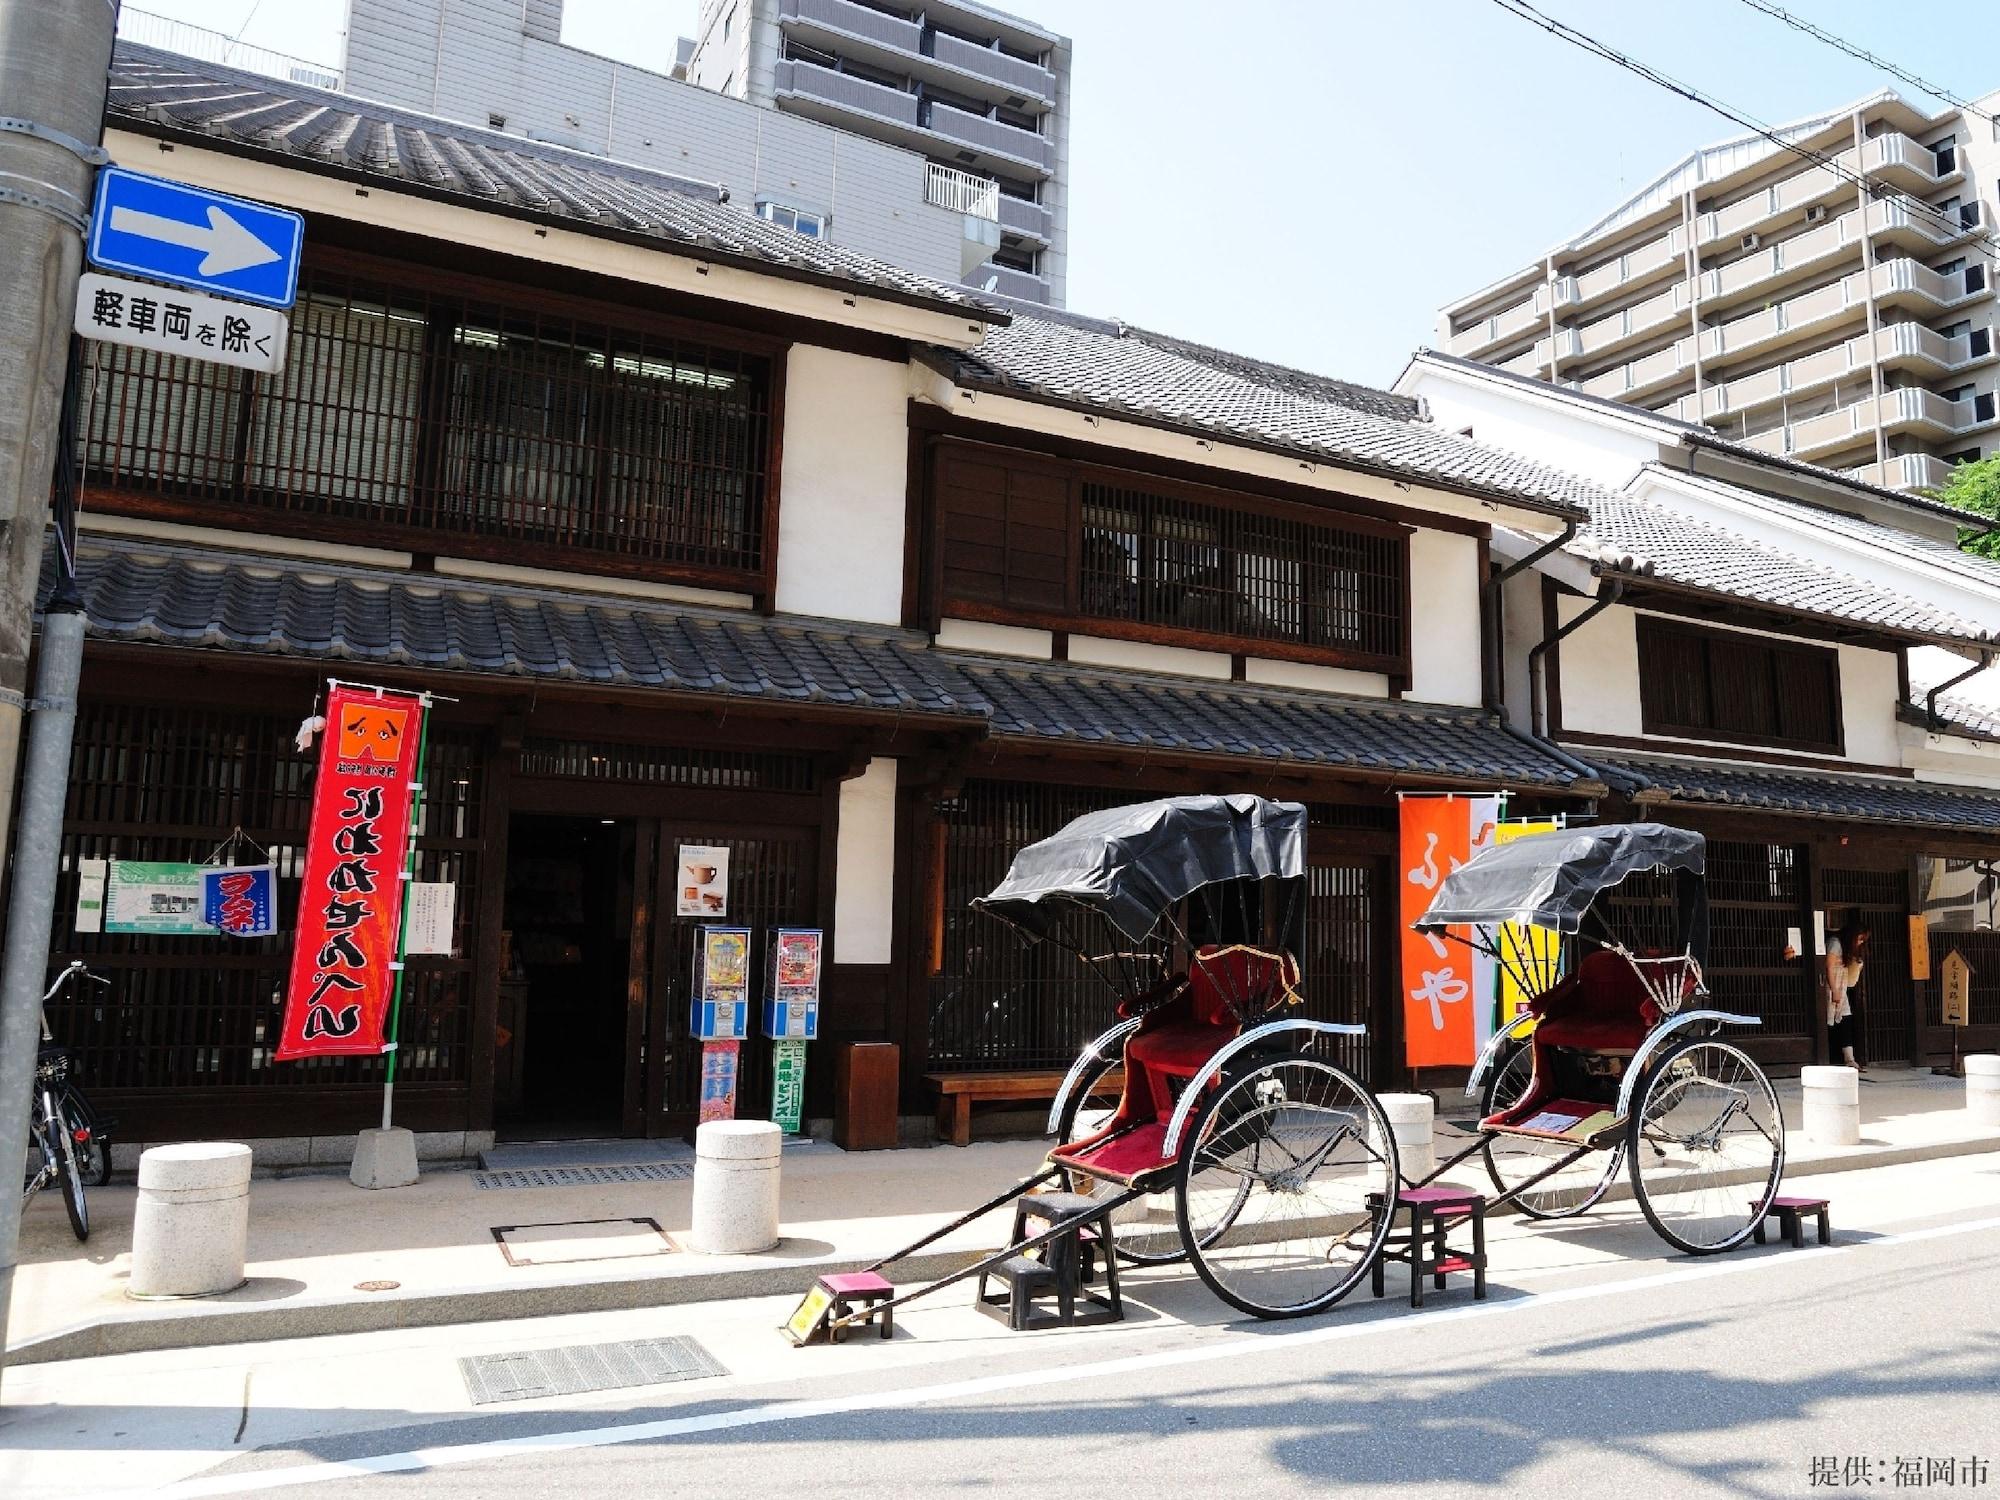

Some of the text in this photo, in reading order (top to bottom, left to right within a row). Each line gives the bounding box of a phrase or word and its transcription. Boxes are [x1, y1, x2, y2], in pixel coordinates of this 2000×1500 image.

[92, 288, 272, 358] 軽車両を除く
[1407, 832, 1469, 1031] ふや
